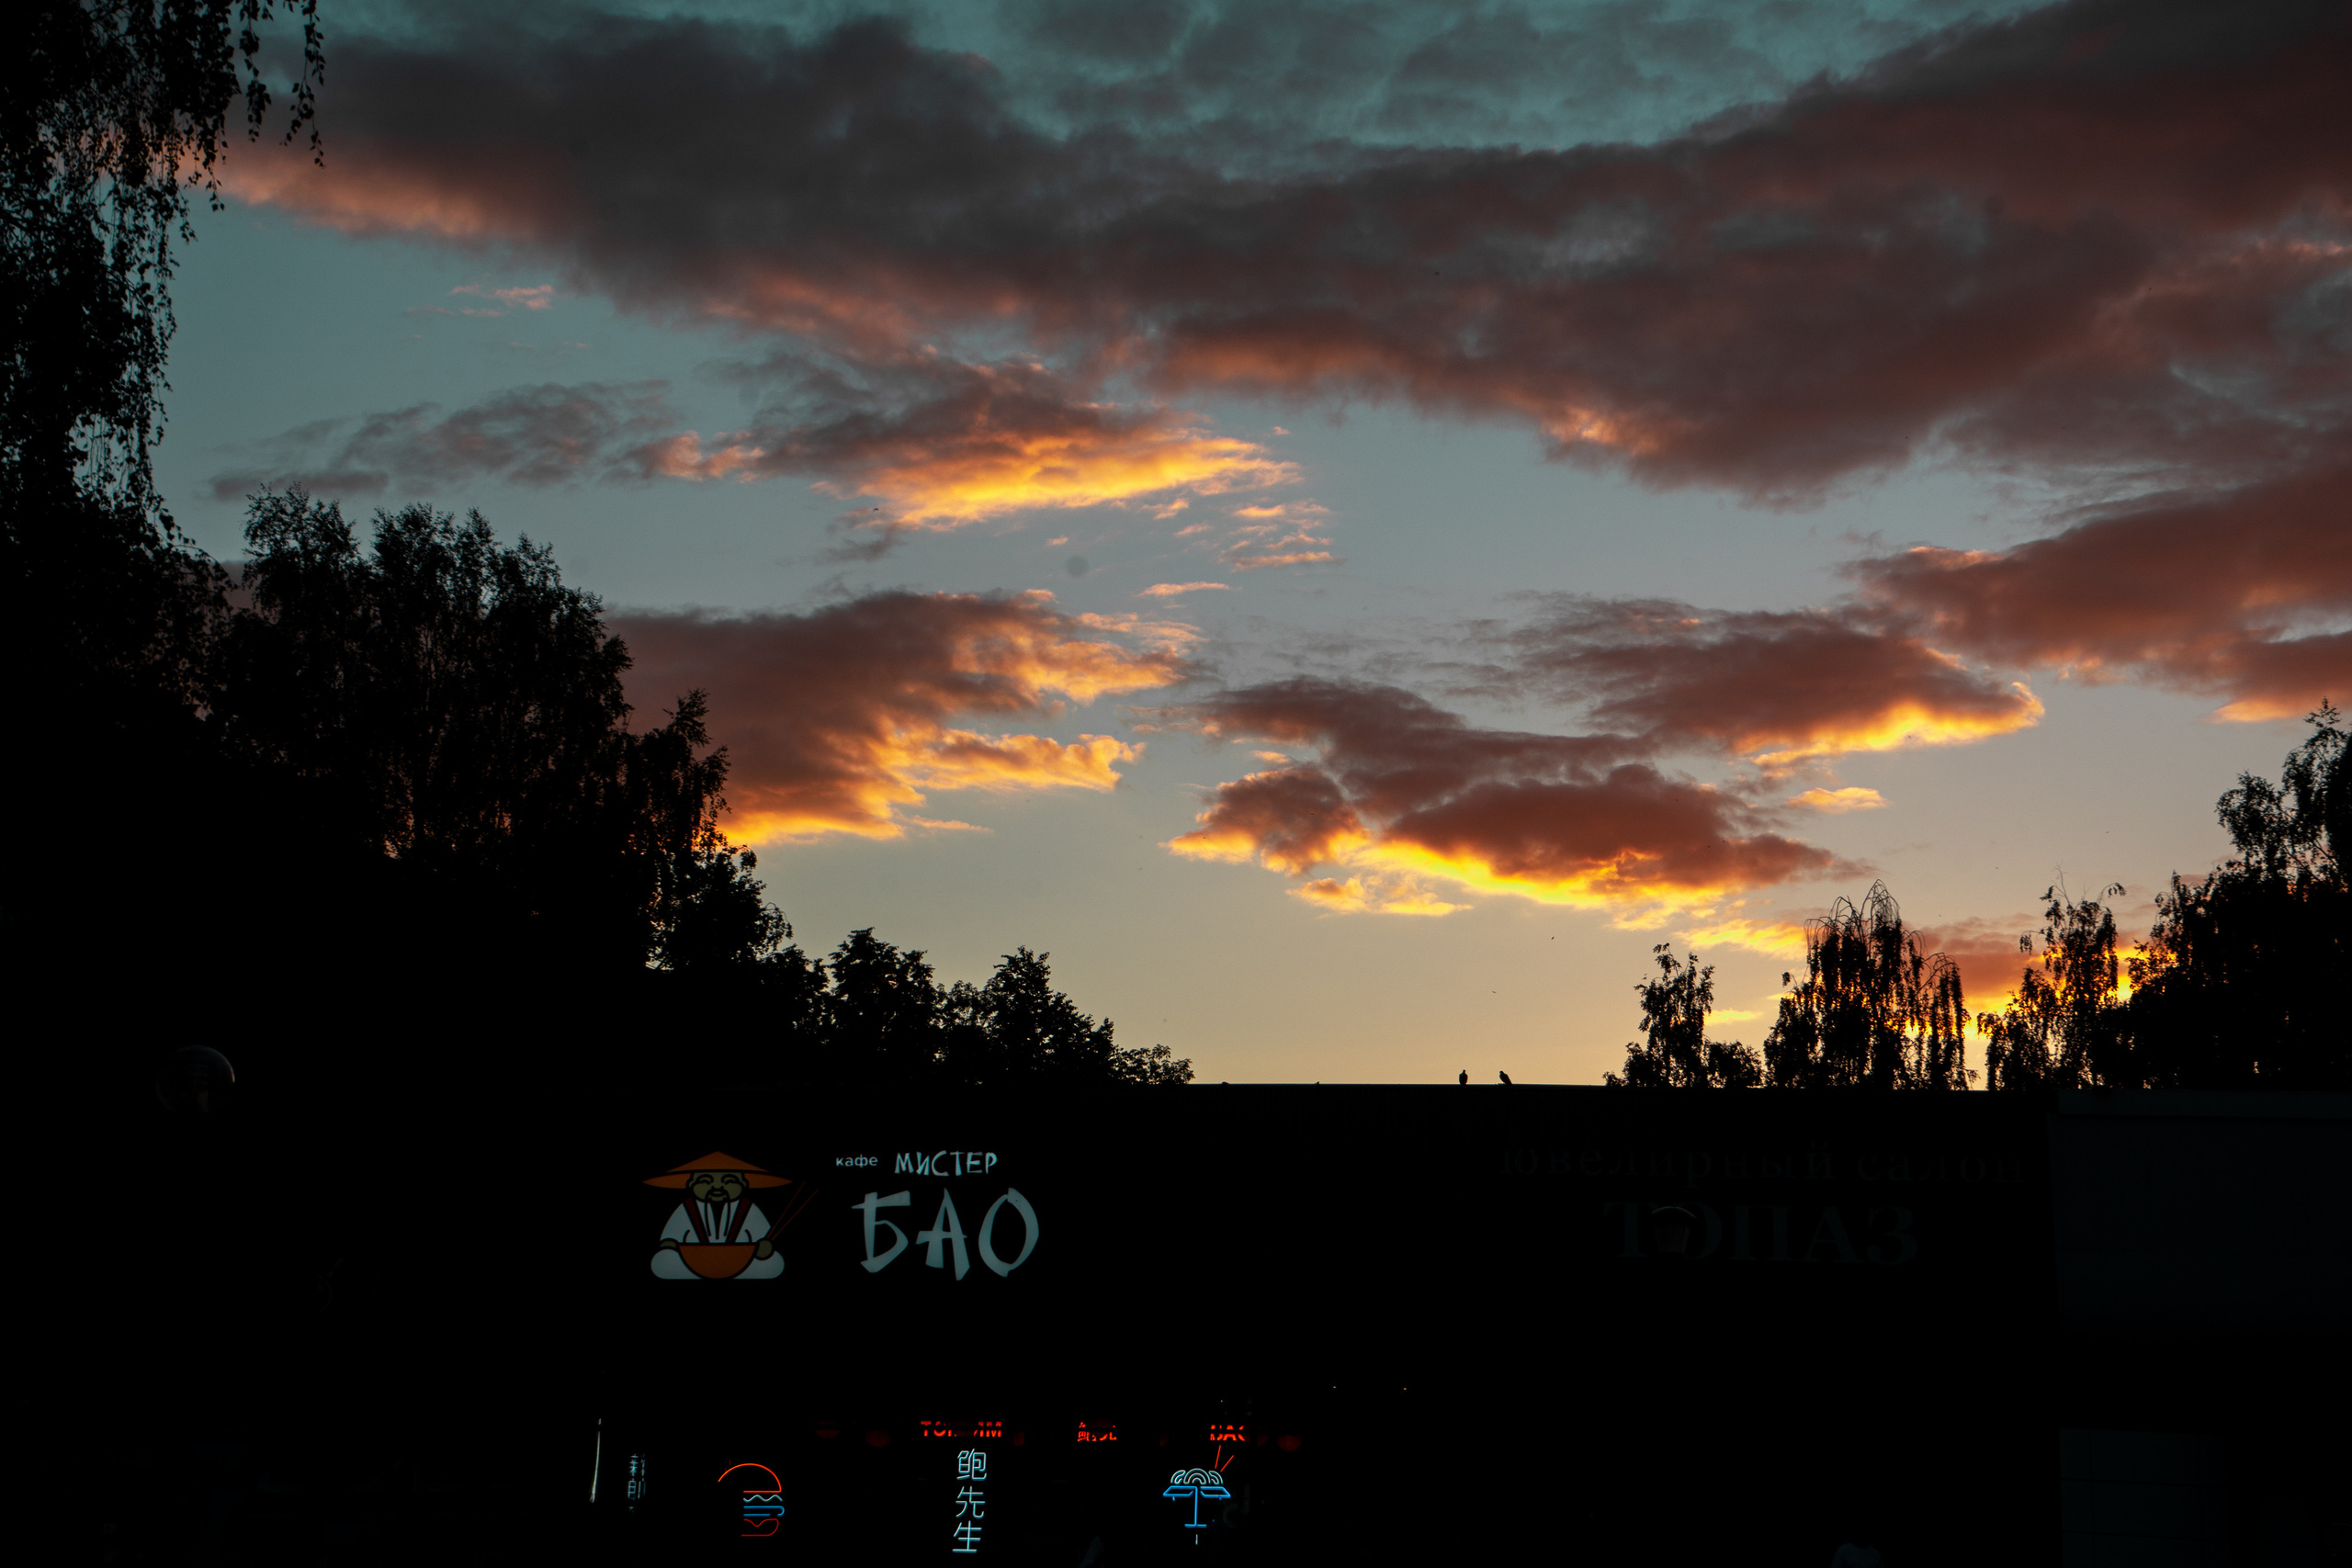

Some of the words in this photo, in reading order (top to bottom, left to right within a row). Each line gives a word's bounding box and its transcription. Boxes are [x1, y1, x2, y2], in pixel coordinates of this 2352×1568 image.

[835, 1154, 878, 1168] кафе
[894, 1150, 998, 1177] МИСТЕР
[1499, 1140, 1836, 1189] ювелирный
[1856, 1153, 2026, 1183] салон
[851, 1187, 1039, 1280] БАО
